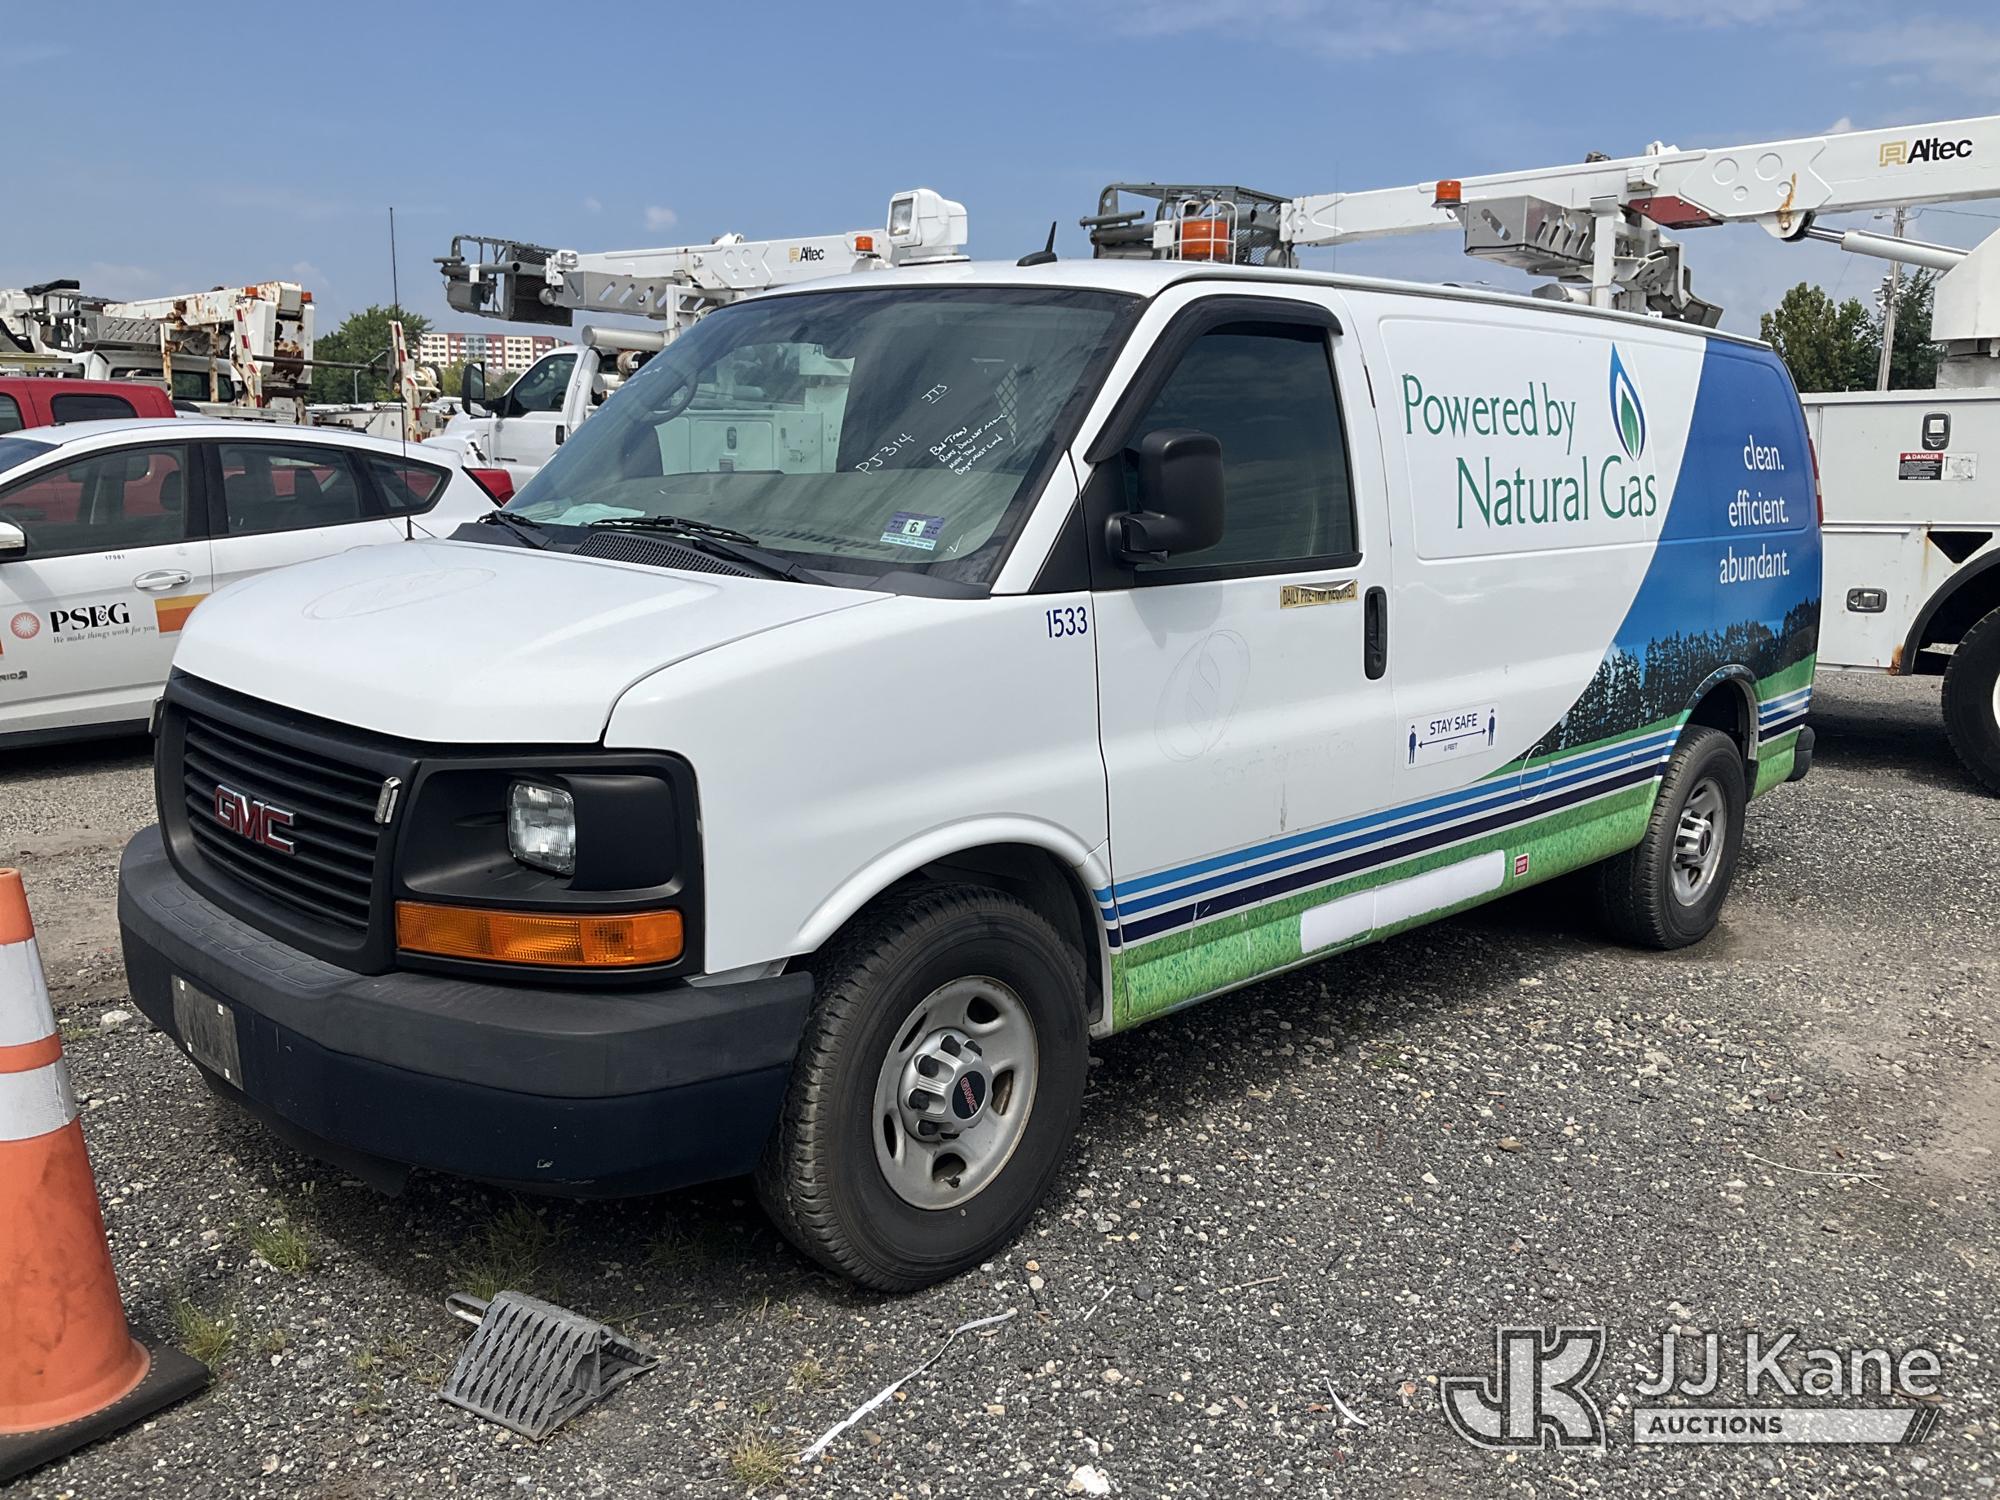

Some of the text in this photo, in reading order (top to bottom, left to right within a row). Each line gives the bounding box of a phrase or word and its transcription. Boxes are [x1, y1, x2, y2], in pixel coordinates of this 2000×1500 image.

[1907, 138, 1973, 163] Altec
[799, 246, 825, 262] Altec
[1402, 374, 1576, 455] Powered by
[855, 433, 915, 475] PJ314
[1743, 434, 1785, 470] clean.
[1456, 454, 1657, 529] Natural Gas
[1728, 489, 1789, 527] efficient.
[909, 521, 919, 533] 6
[1719, 543, 1790, 584] abundant.
[1046, 606, 1088, 638] 1533
[1429, 713, 1478, 735] STAY SAFE
[215, 785, 295, 855] GMC
[960, 1076, 979, 1114] GMC
